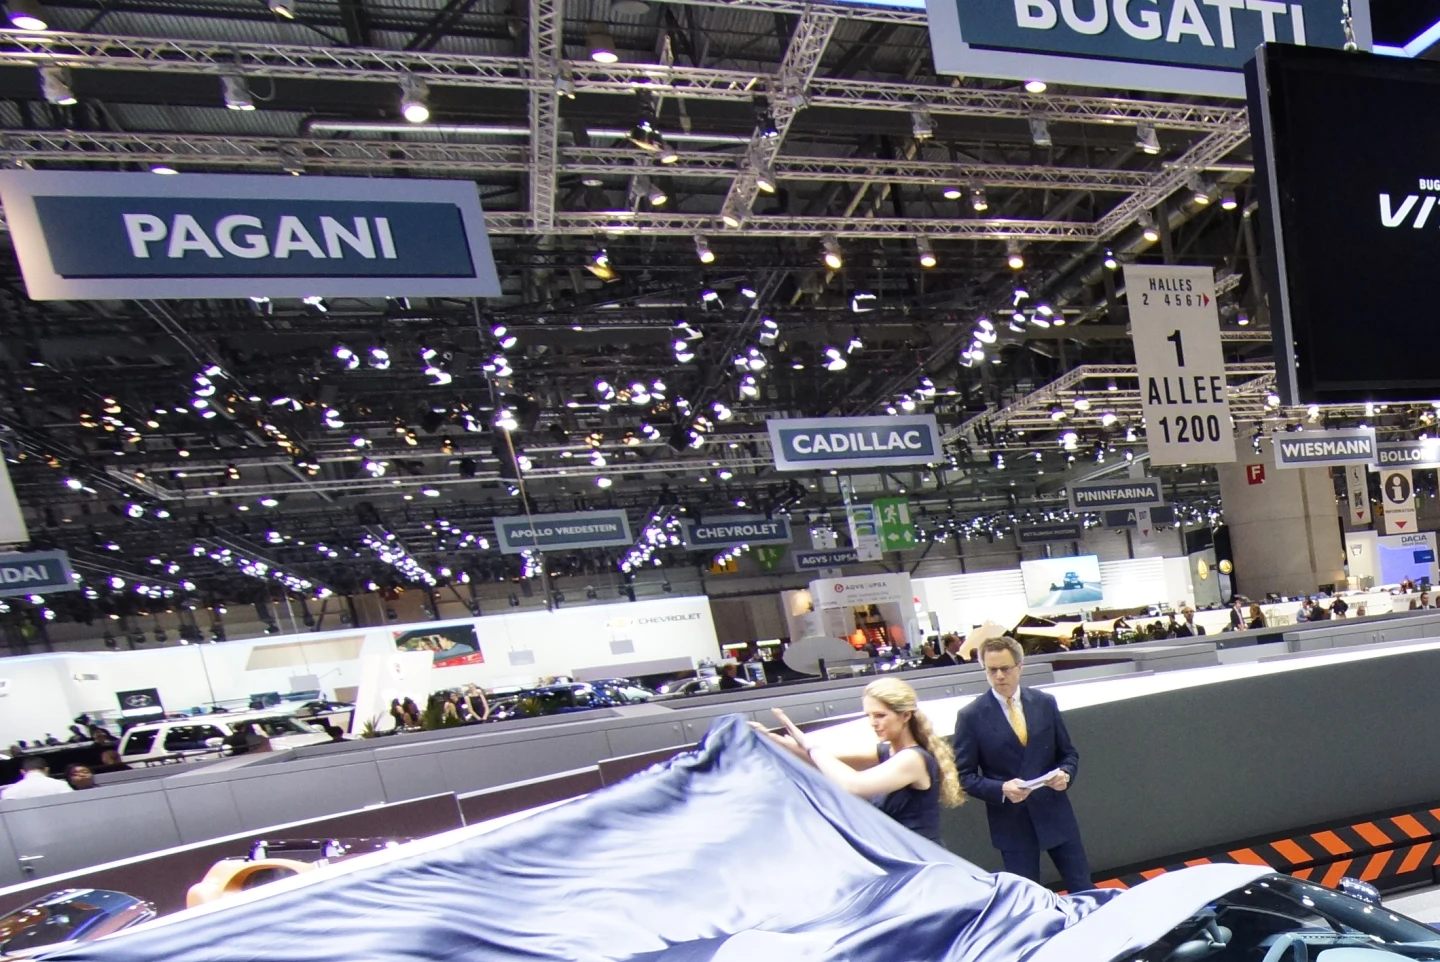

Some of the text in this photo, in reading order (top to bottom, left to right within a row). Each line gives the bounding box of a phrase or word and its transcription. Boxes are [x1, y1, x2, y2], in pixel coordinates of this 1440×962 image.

[1014, 0, 1307, 49] BUGATTI
[122, 212, 398, 260] PAGANI
[1149, 278, 1193, 292] HALLES
[1167, 329, 1185, 367] 1
[1148, 376, 1225, 405] ALLEE
[1158, 414, 1221, 443] 1200
[792, 430, 922, 454] CADILLAC
[1281, 439, 1371, 458] WIESMANN
[1251, 468, 1261, 481] F
[1076, 487, 1155, 502] PININFARINA
[510, 523, 618, 539] APOLLO VREDESTEIN
[696, 523, 778, 539] CHEVROLET
[1401, 534, 1428, 543] DACIA
[802, 555, 828, 565] AGVS
[0, 564, 49, 584] DAI
[638, 612, 702, 625] CHEVROLET
